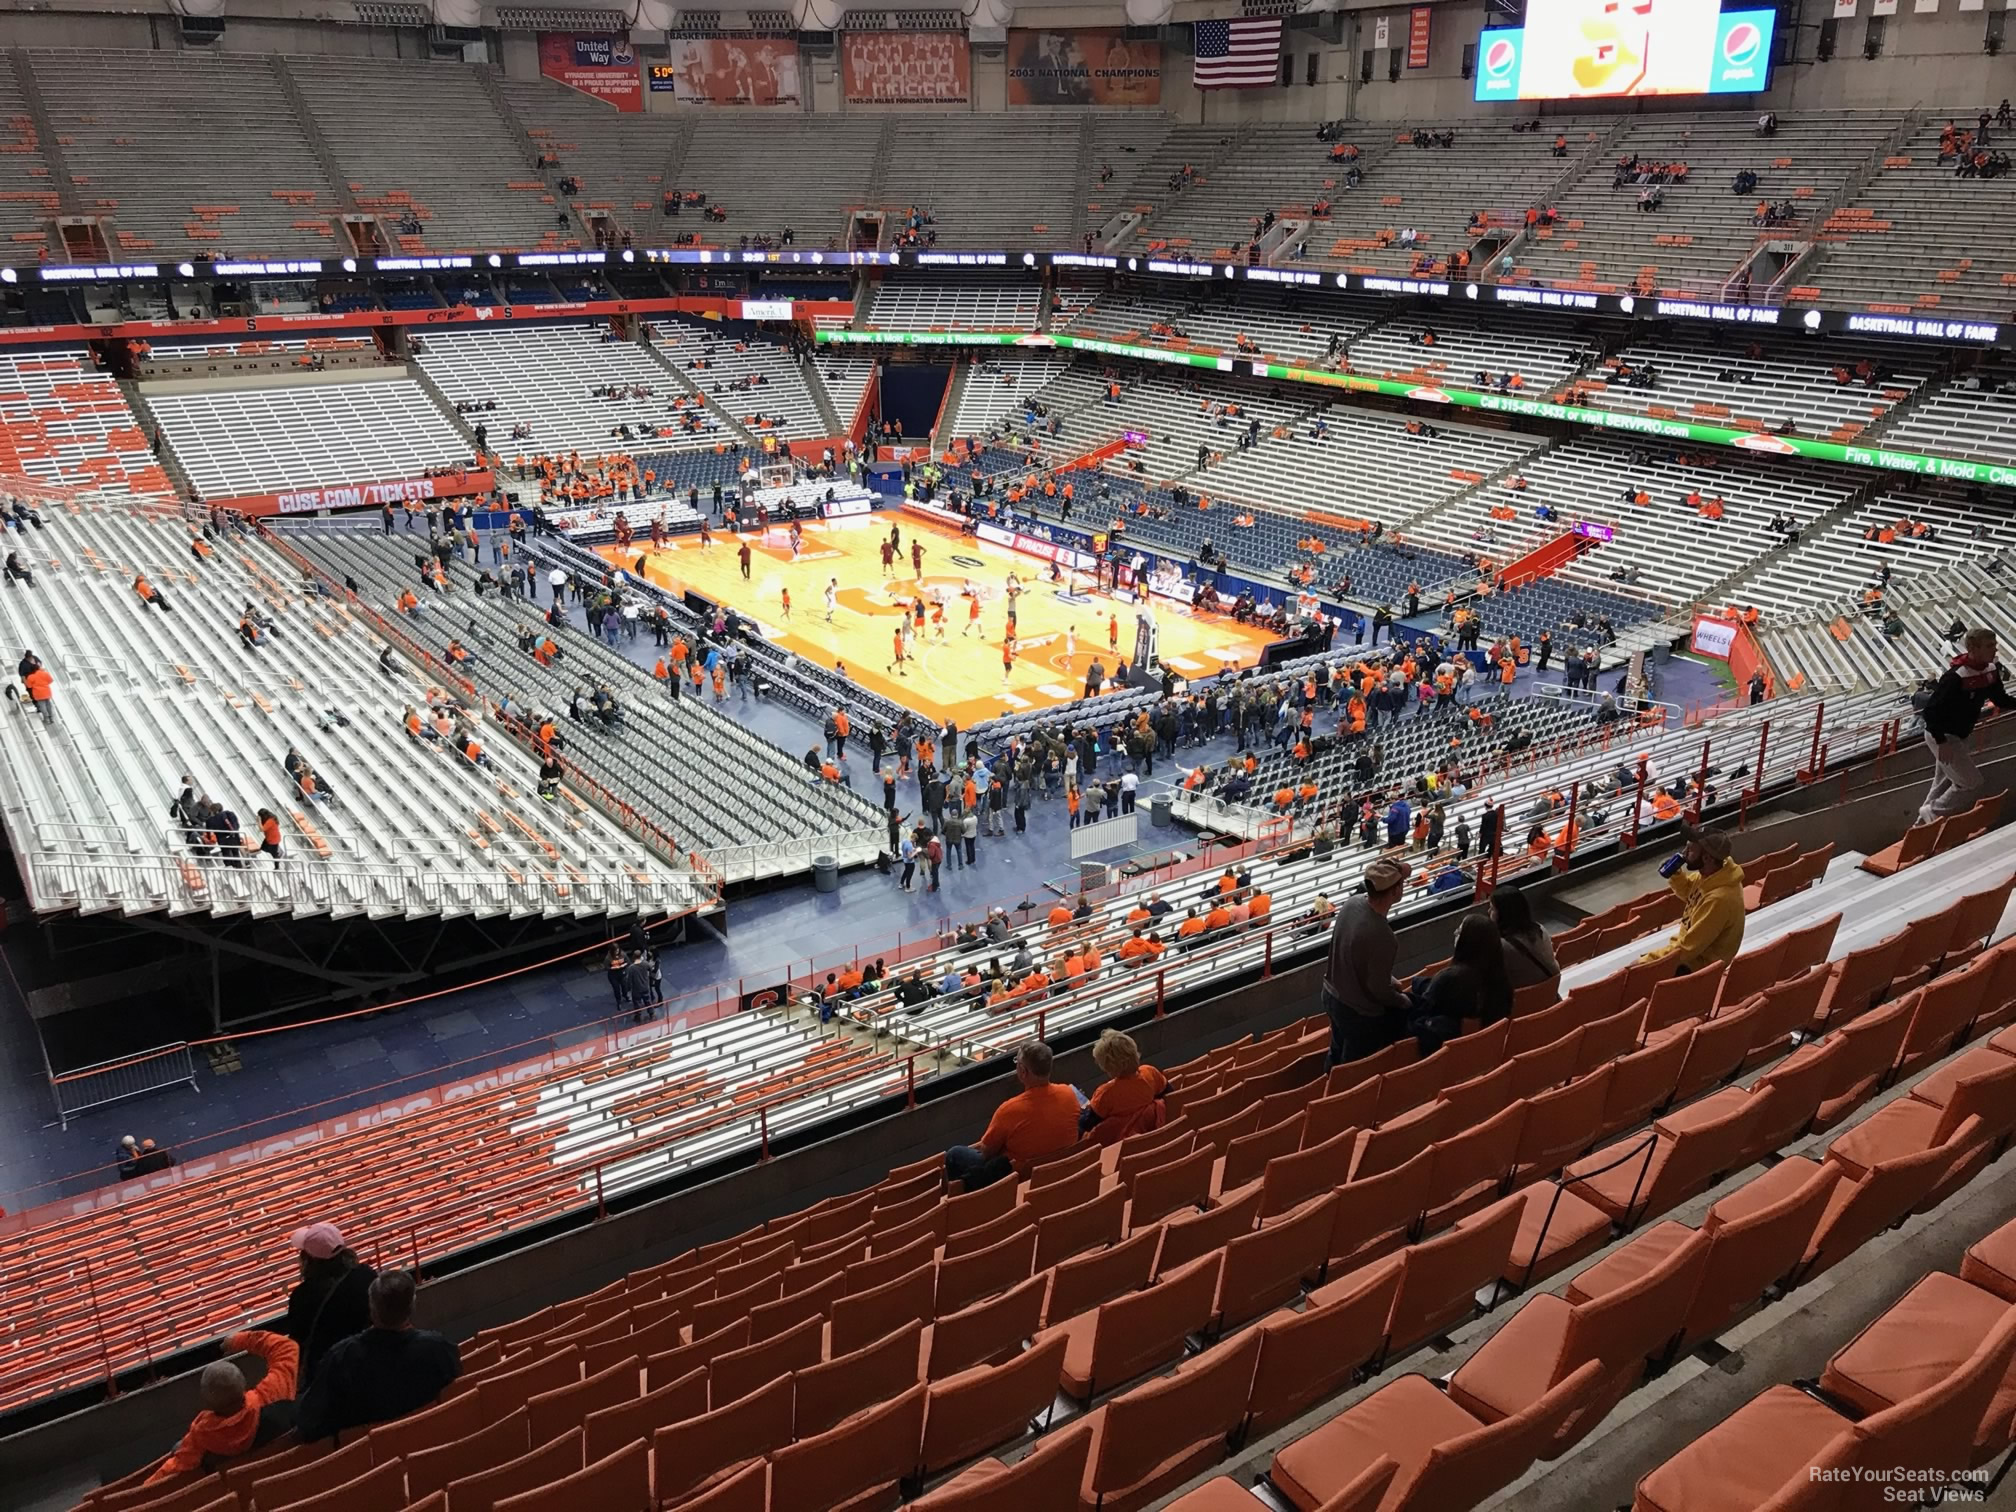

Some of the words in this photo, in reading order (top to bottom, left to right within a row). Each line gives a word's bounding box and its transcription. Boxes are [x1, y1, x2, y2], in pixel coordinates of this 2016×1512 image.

[670, 32, 728, 40] BASKETBALL
[729, 32, 754, 40] HALL
[1378, 30, 1386, 39] 15
[576, 41, 609, 52] United
[590, 52, 610, 65] Way
[1009, 69, 1036, 77] 2003
[1038, 69, 1092, 78] NATIONAL
[1095, 69, 1161, 78] CHAMPIONS
[918, 254, 958, 264] BASKETBALL
[960, 254, 976, 264] HALL
[978, 255, 987, 264] OF
[1364, 278, 1401, 291] BASKETBALL
[1403, 281, 1418, 292] HALL
[1420, 283, 1429, 294] OF
[1431, 284, 1449, 295] FAME
[1497, 288, 1542, 303] BASKETBALL
[1543, 292, 1562, 304] HALL
[1563, 294, 1574, 306] OF
[1575, 295, 1597, 308] FAME
[504, 307, 513, 318] S
[1658, 302, 1711, 318] BASKETBALL
[1712, 305, 1735, 319] HALL
[1737, 307, 1750, 320] OF
[1752, 309, 1779, 323] FAME
[247, 319, 257, 332] S
[1850, 317, 1913, 335] BASKETBALL
[1916, 321, 1944, 337] HALL
[1947, 324, 1962, 338] OF
[1965, 326, 1998, 342] FAME
[828, 333, 846, 344] Fire,
[847, 333, 875, 344] Water,
[876, 334, 883, 343] &
[884, 334, 904, 343] Mold
[911, 335, 945, 346] Cleanup
[946, 335, 953, 344] &
[954, 335, 1001, 344] Restoration
[1480, 395, 1499, 408] Call
[1501, 398, 1565, 419] 315-457-3432
[1568, 410, 1579, 420] or
[1581, 408, 1604, 424] visit
[1606, 413, 1690, 438] SERVPRO.com
[1845, 447, 1874, 466] Fire,
[1879, 452, 1921, 473] Water,
[1925, 461, 1936, 473] &
[1940, 461, 1976, 479] Mold
[278, 480, 435, 513] CUSE.COM/TICKETS
[1016, 537, 1056, 558] SYRACUSE
[1696, 631, 1727, 645] WHEELS
